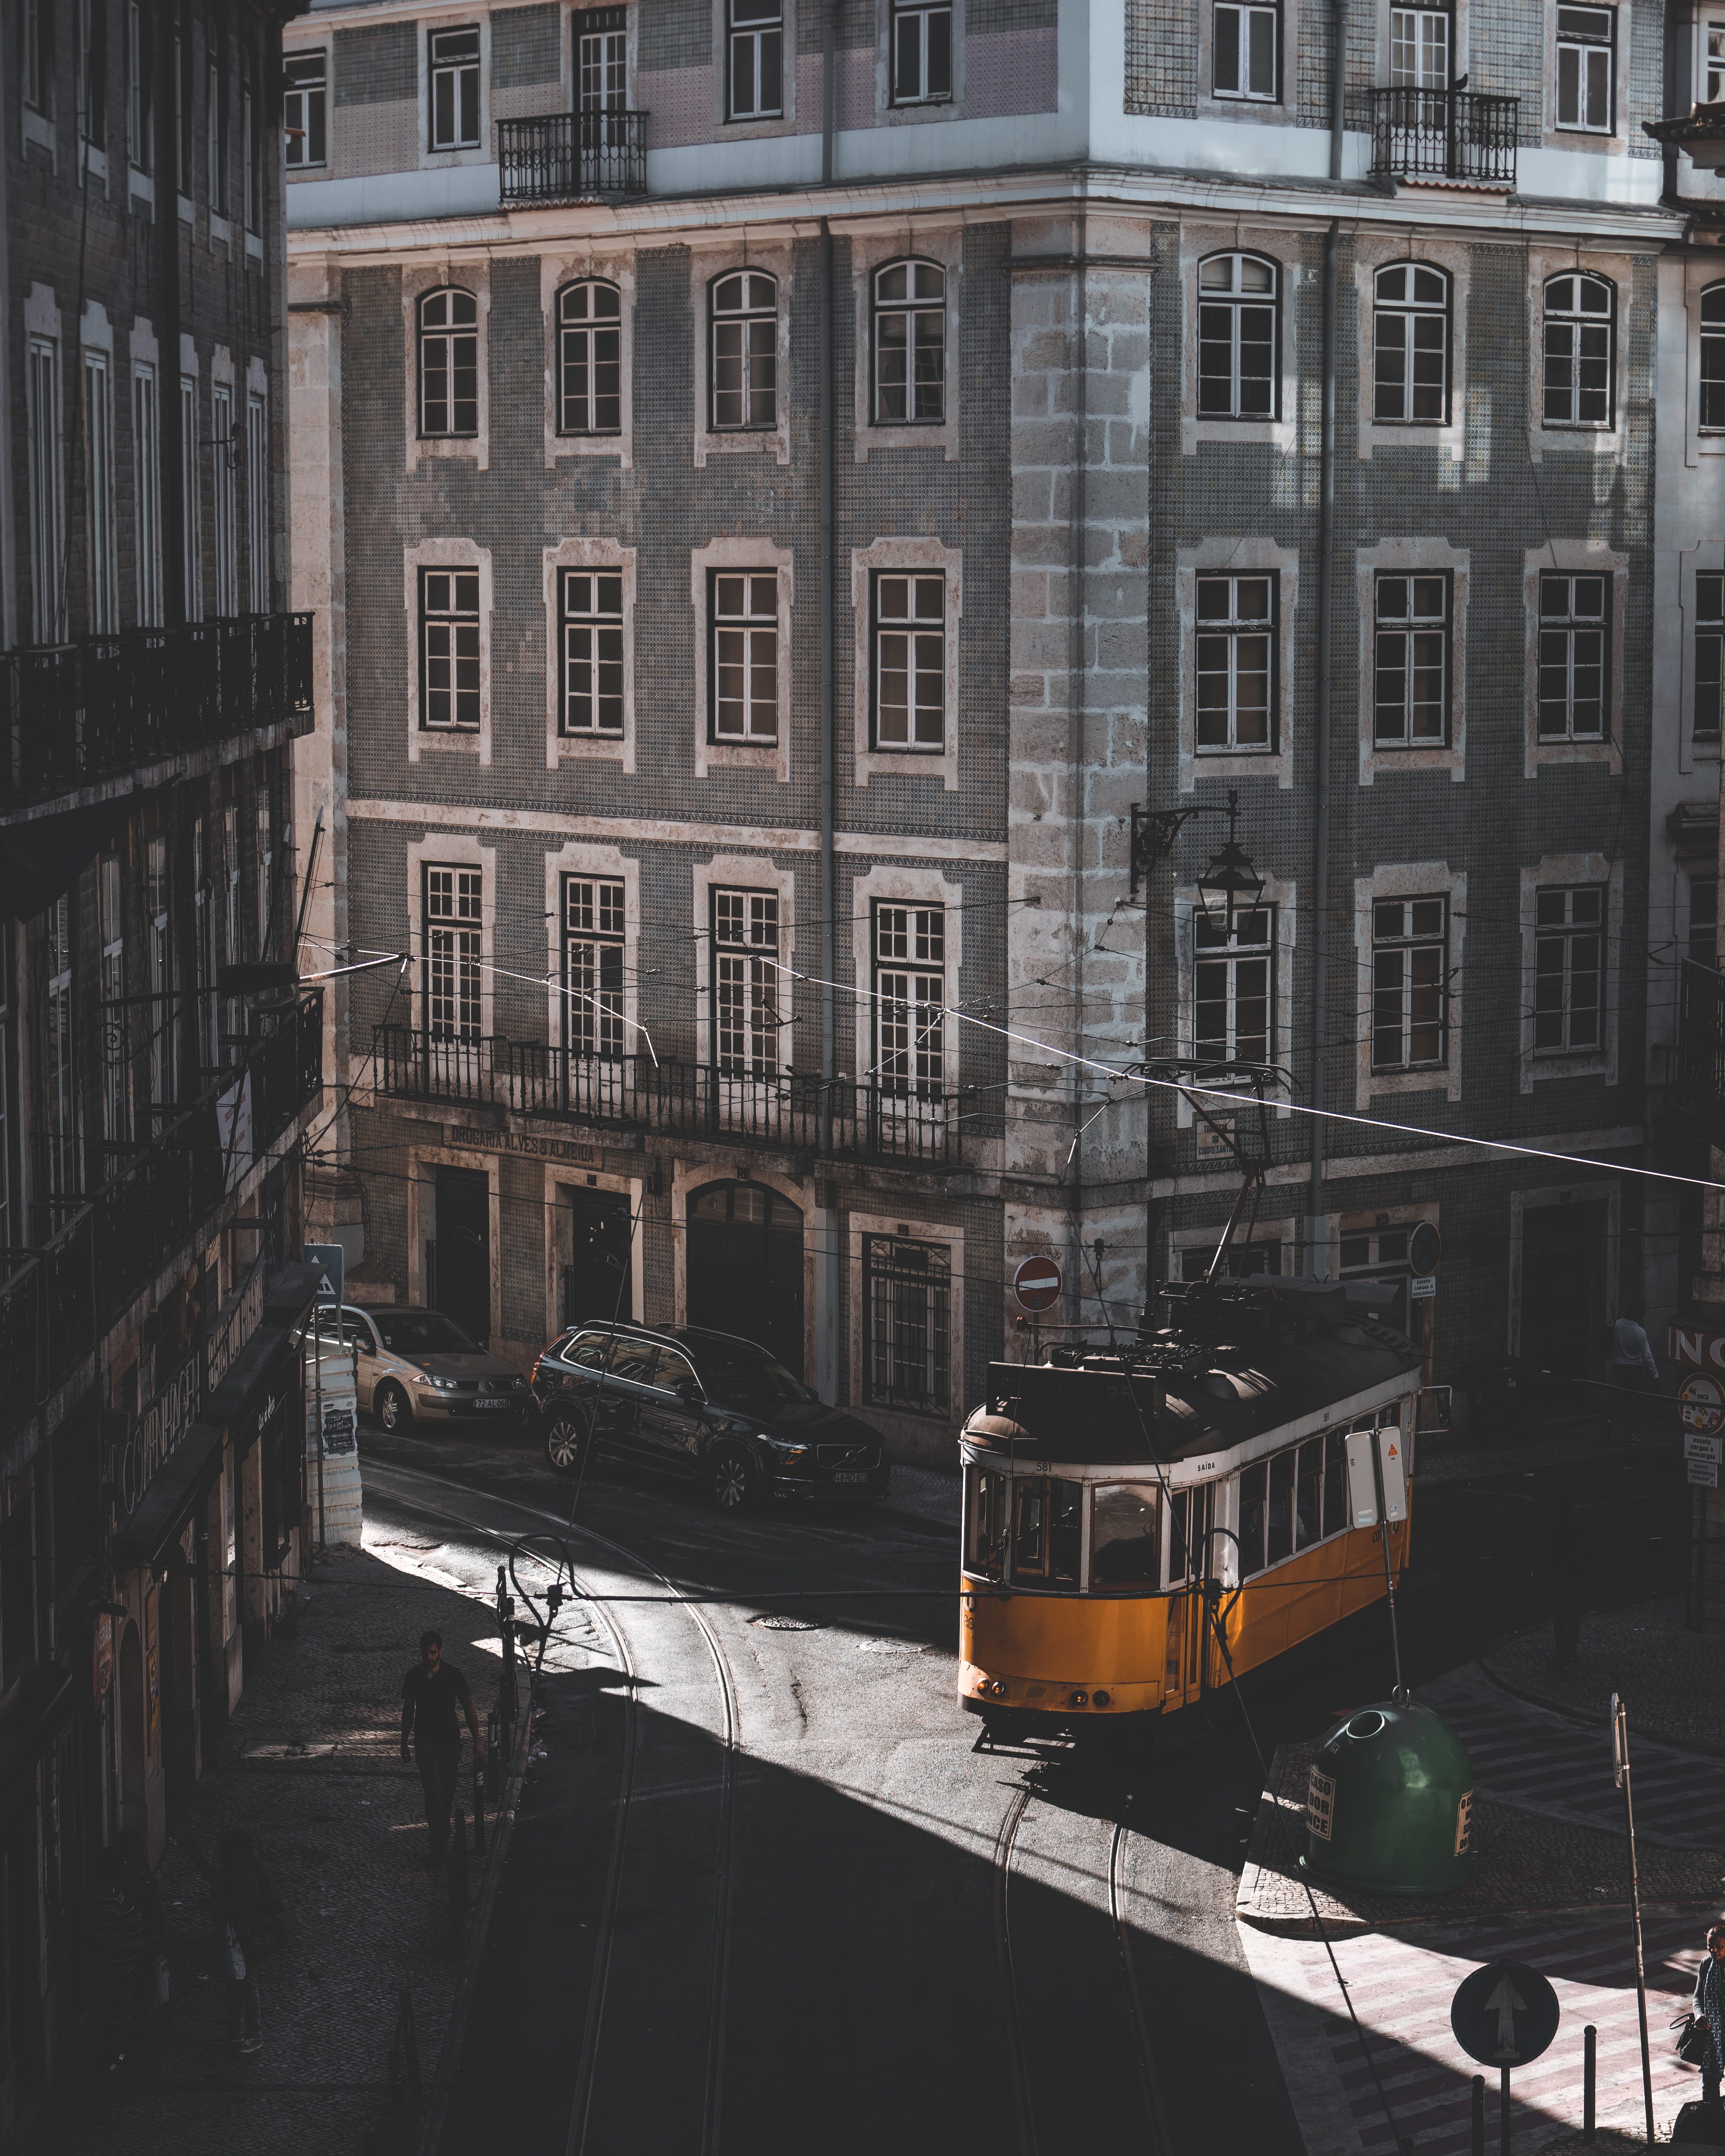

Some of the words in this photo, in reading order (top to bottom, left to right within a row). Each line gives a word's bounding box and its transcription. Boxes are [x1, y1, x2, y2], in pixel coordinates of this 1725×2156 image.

[505, 1133, 538, 1154] ALVES
[540, 1139, 547, 1156] &
[550, 1141, 594, 1163] ALMEIDA
[1198, 1147, 1215, 1155] CORPO
[1688, 1451, 1715, 1459] descargas
[1036, 1463, 1051, 1472] 581
[1198, 1463, 1215, 1472] SAÍDA
[1688, 1469, 1714, 1477] TRANSPORTES
